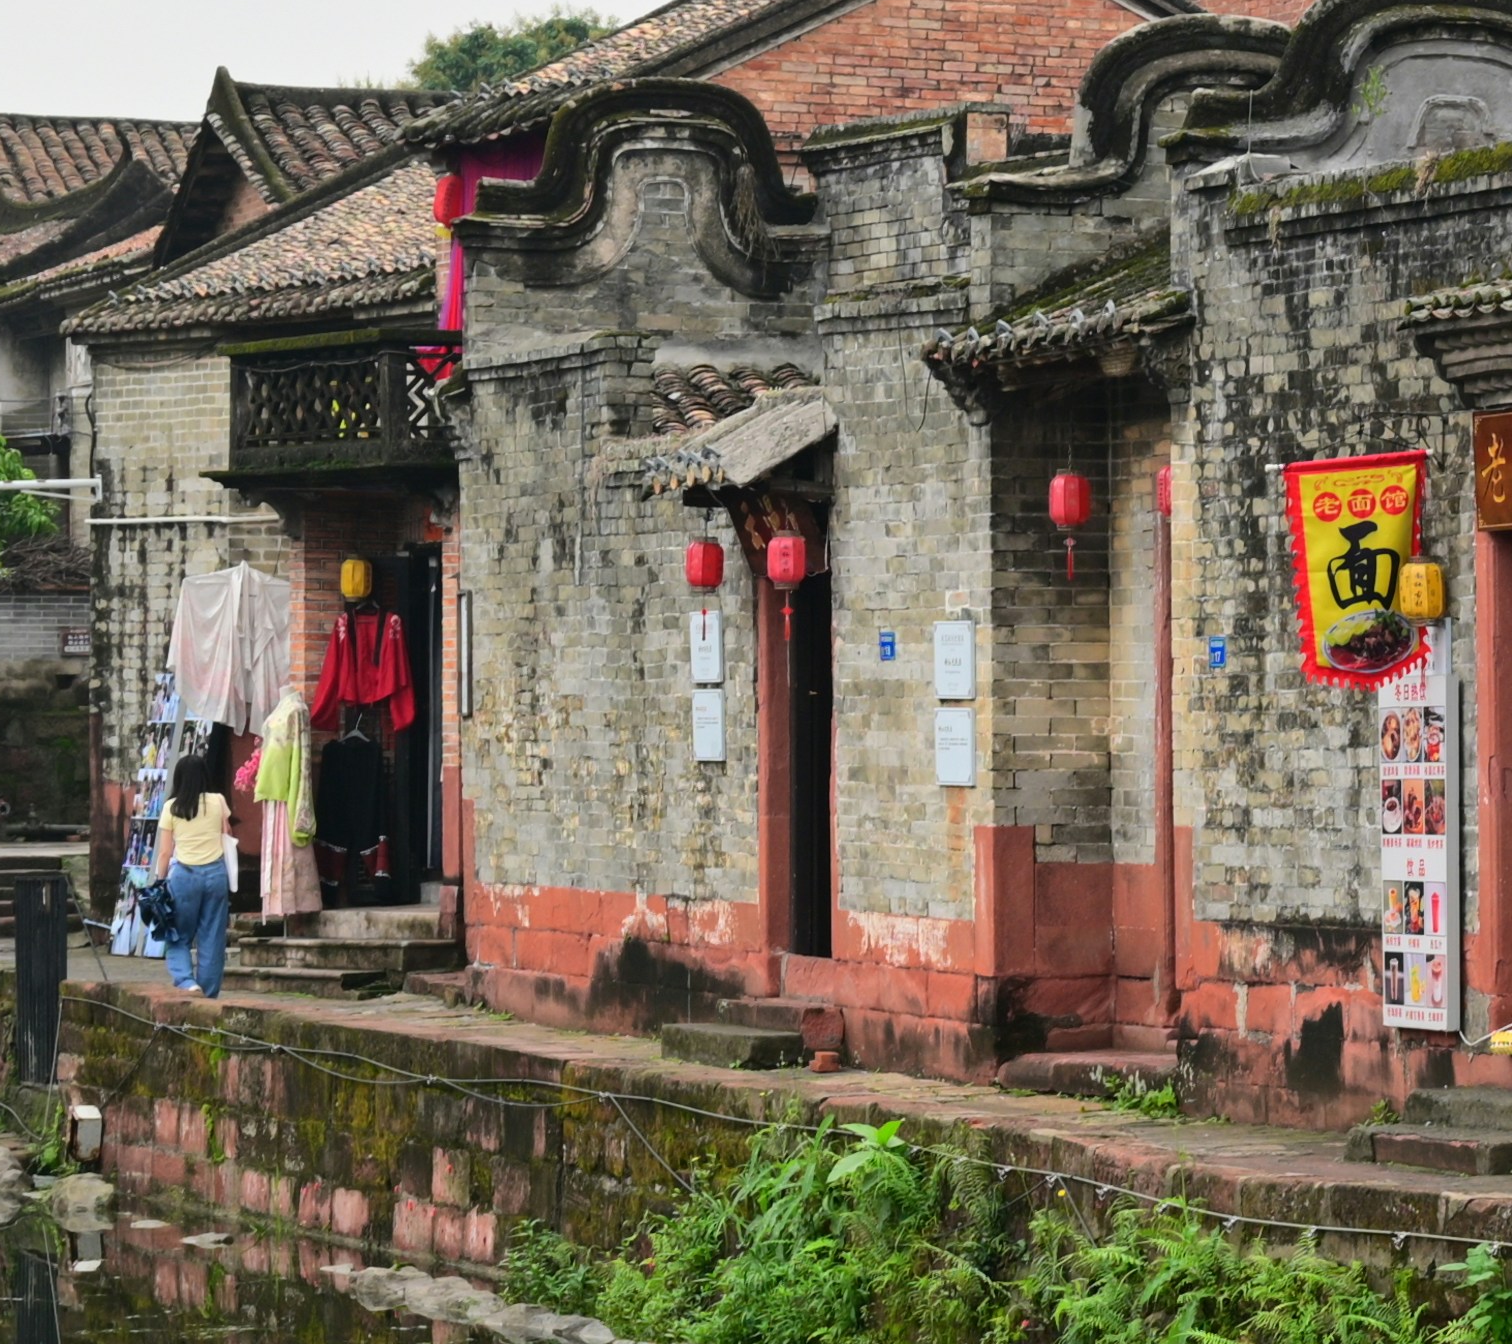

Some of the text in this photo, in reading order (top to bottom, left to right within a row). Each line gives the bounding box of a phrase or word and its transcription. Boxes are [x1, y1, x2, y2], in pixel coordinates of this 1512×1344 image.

[1315, 488, 1408, 515] 老面馆
[1327, 520, 1401, 611] 面
